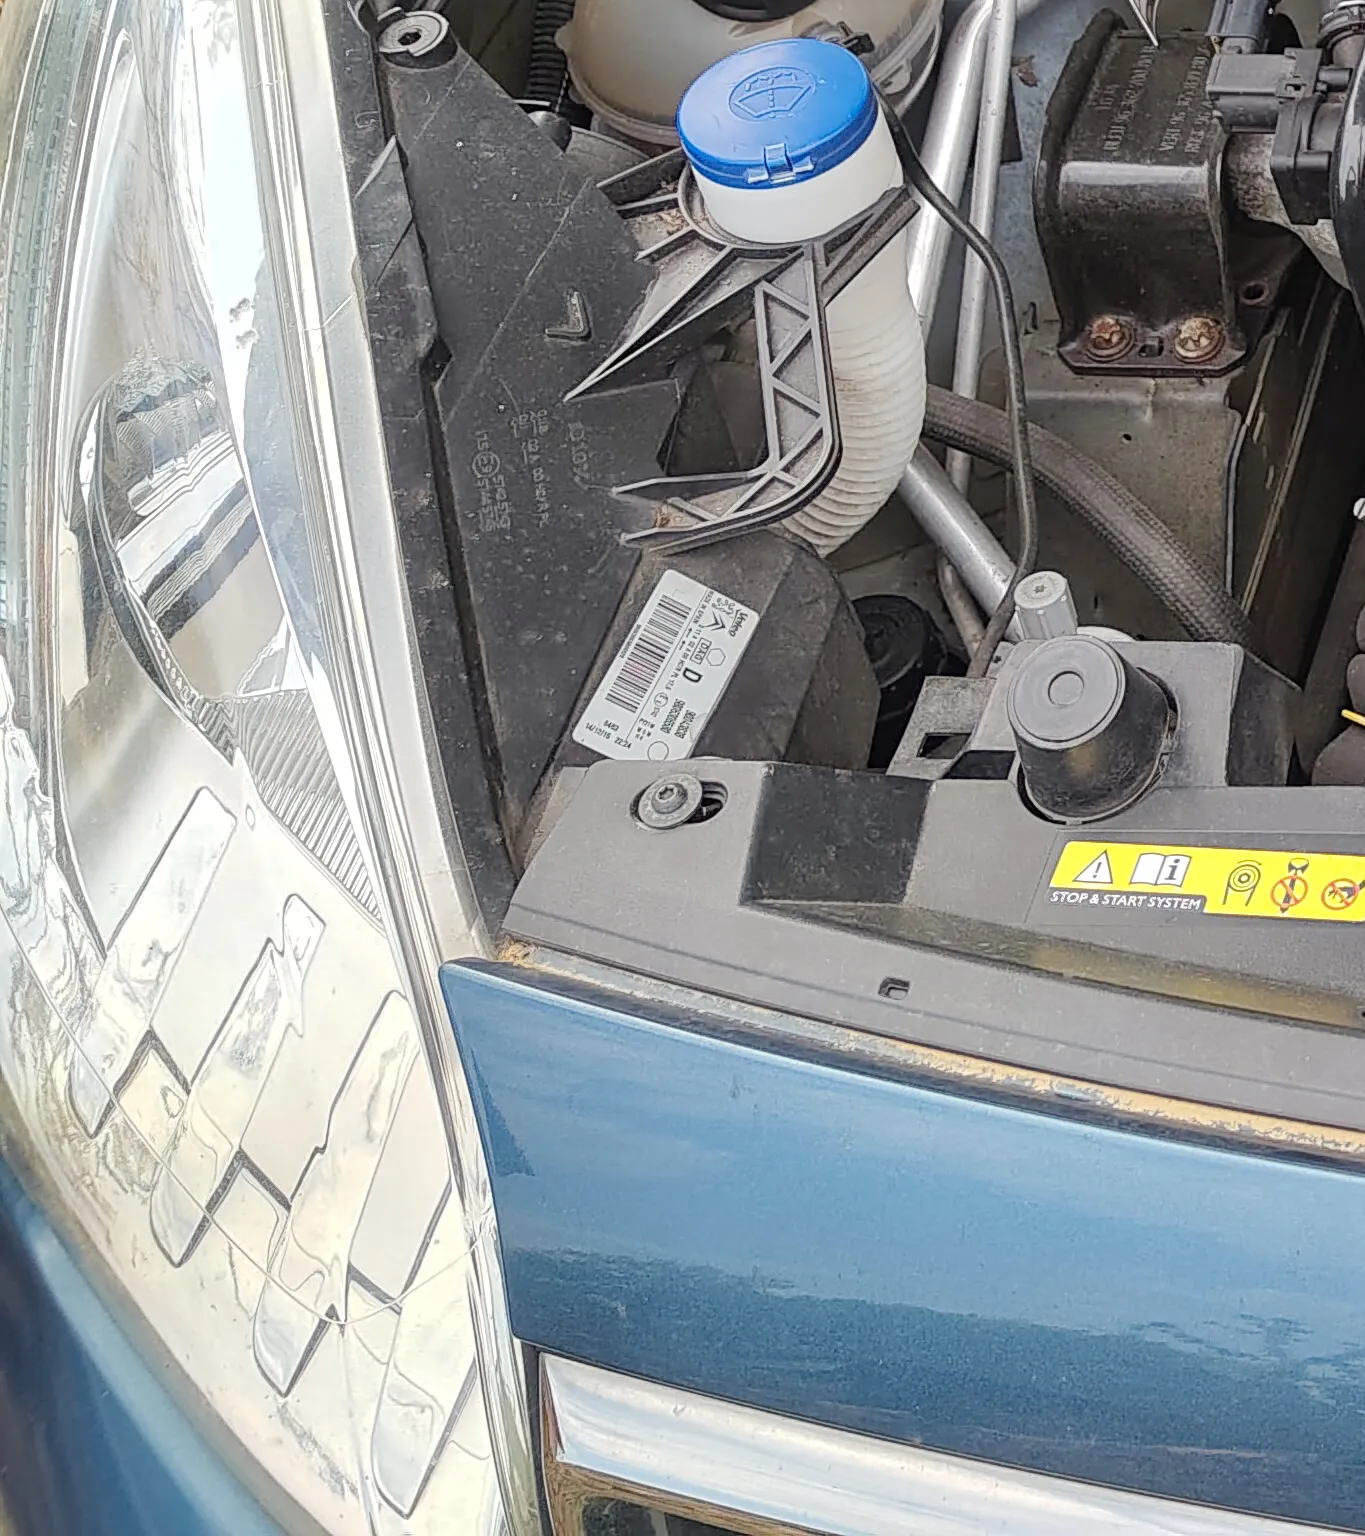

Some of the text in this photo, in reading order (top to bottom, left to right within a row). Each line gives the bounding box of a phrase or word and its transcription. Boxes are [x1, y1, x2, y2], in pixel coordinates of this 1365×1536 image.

[729, 610, 750, 639] Valeo
[682, 667, 703, 685] D
[1050, 890, 1203, 911] STOP & START SYSTEM
